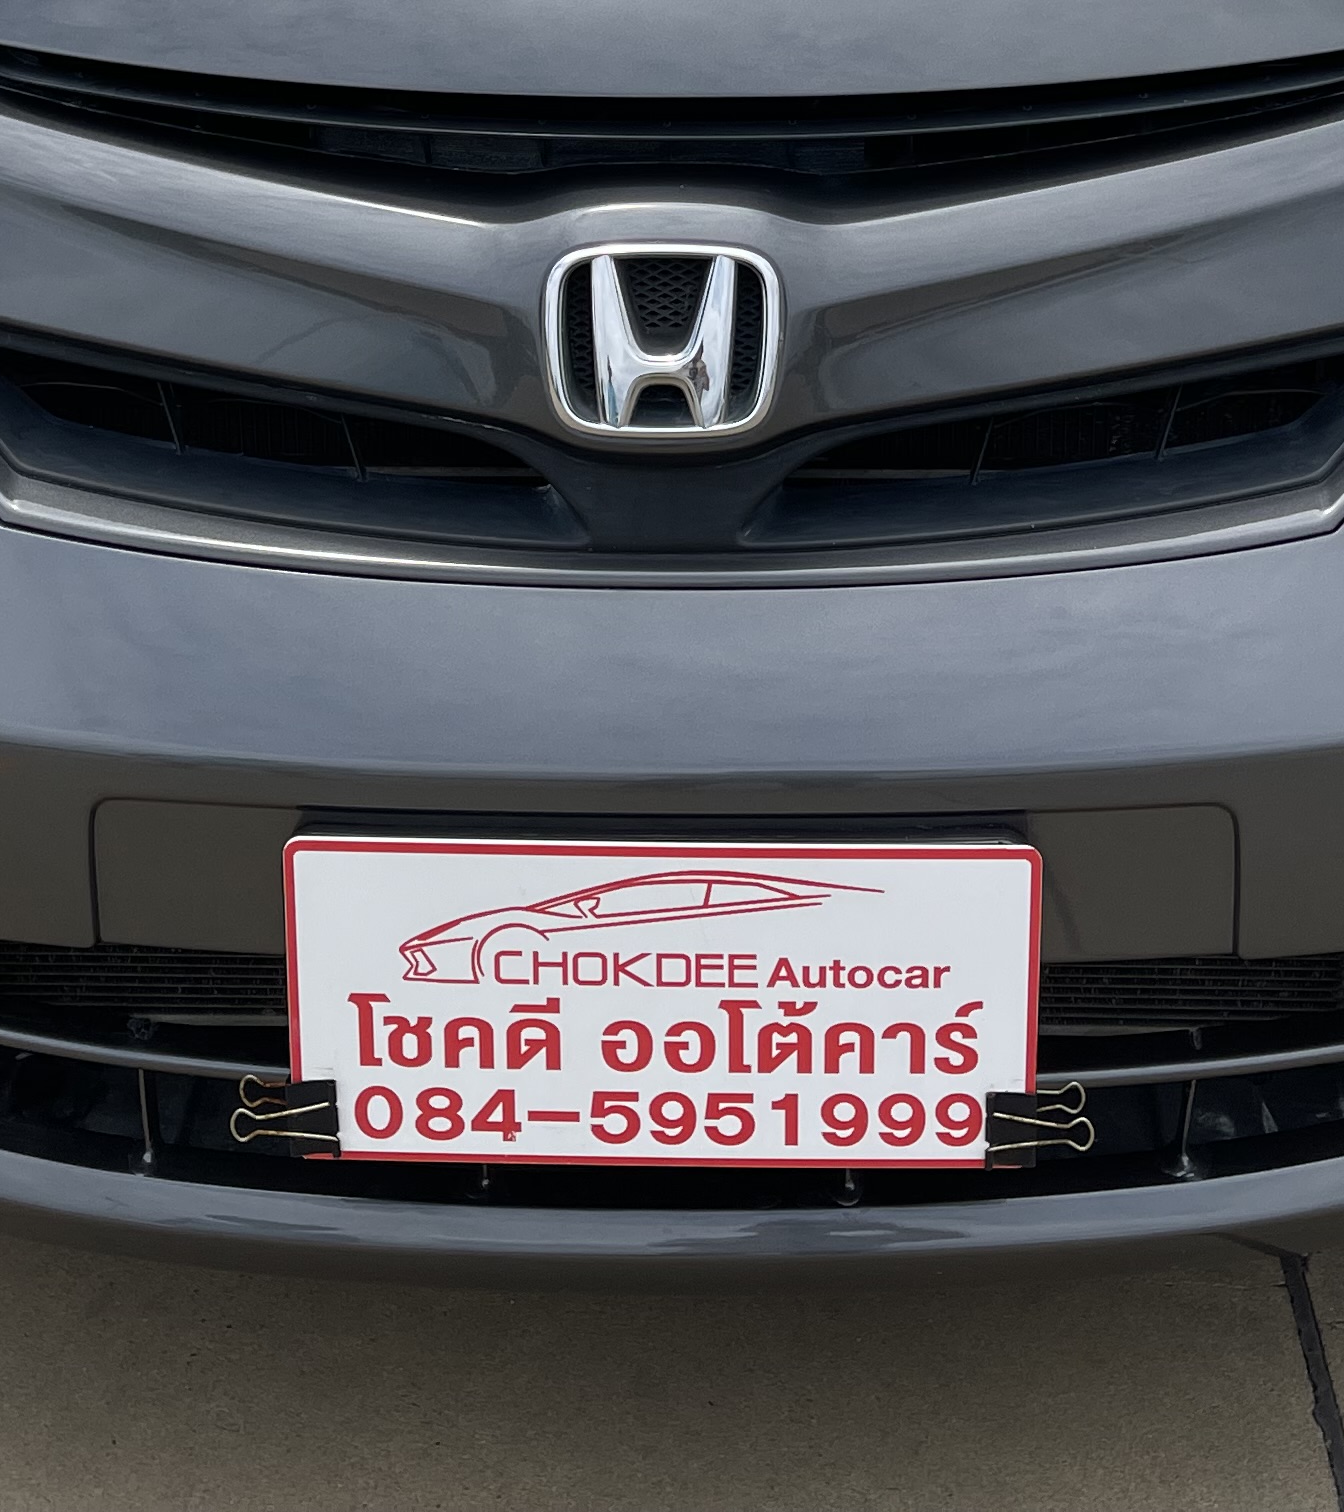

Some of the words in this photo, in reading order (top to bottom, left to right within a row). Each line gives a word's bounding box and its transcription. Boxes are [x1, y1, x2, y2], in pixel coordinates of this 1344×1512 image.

[493, 949, 758, 989] CHOKDEE
[767, 957, 951, 989] Autocar
[347, 992, 562, 1071] โชคดี
[600, 999, 983, 1075] ออโต้คาร์
[353, 1085, 984, 1147] 084-5951999
